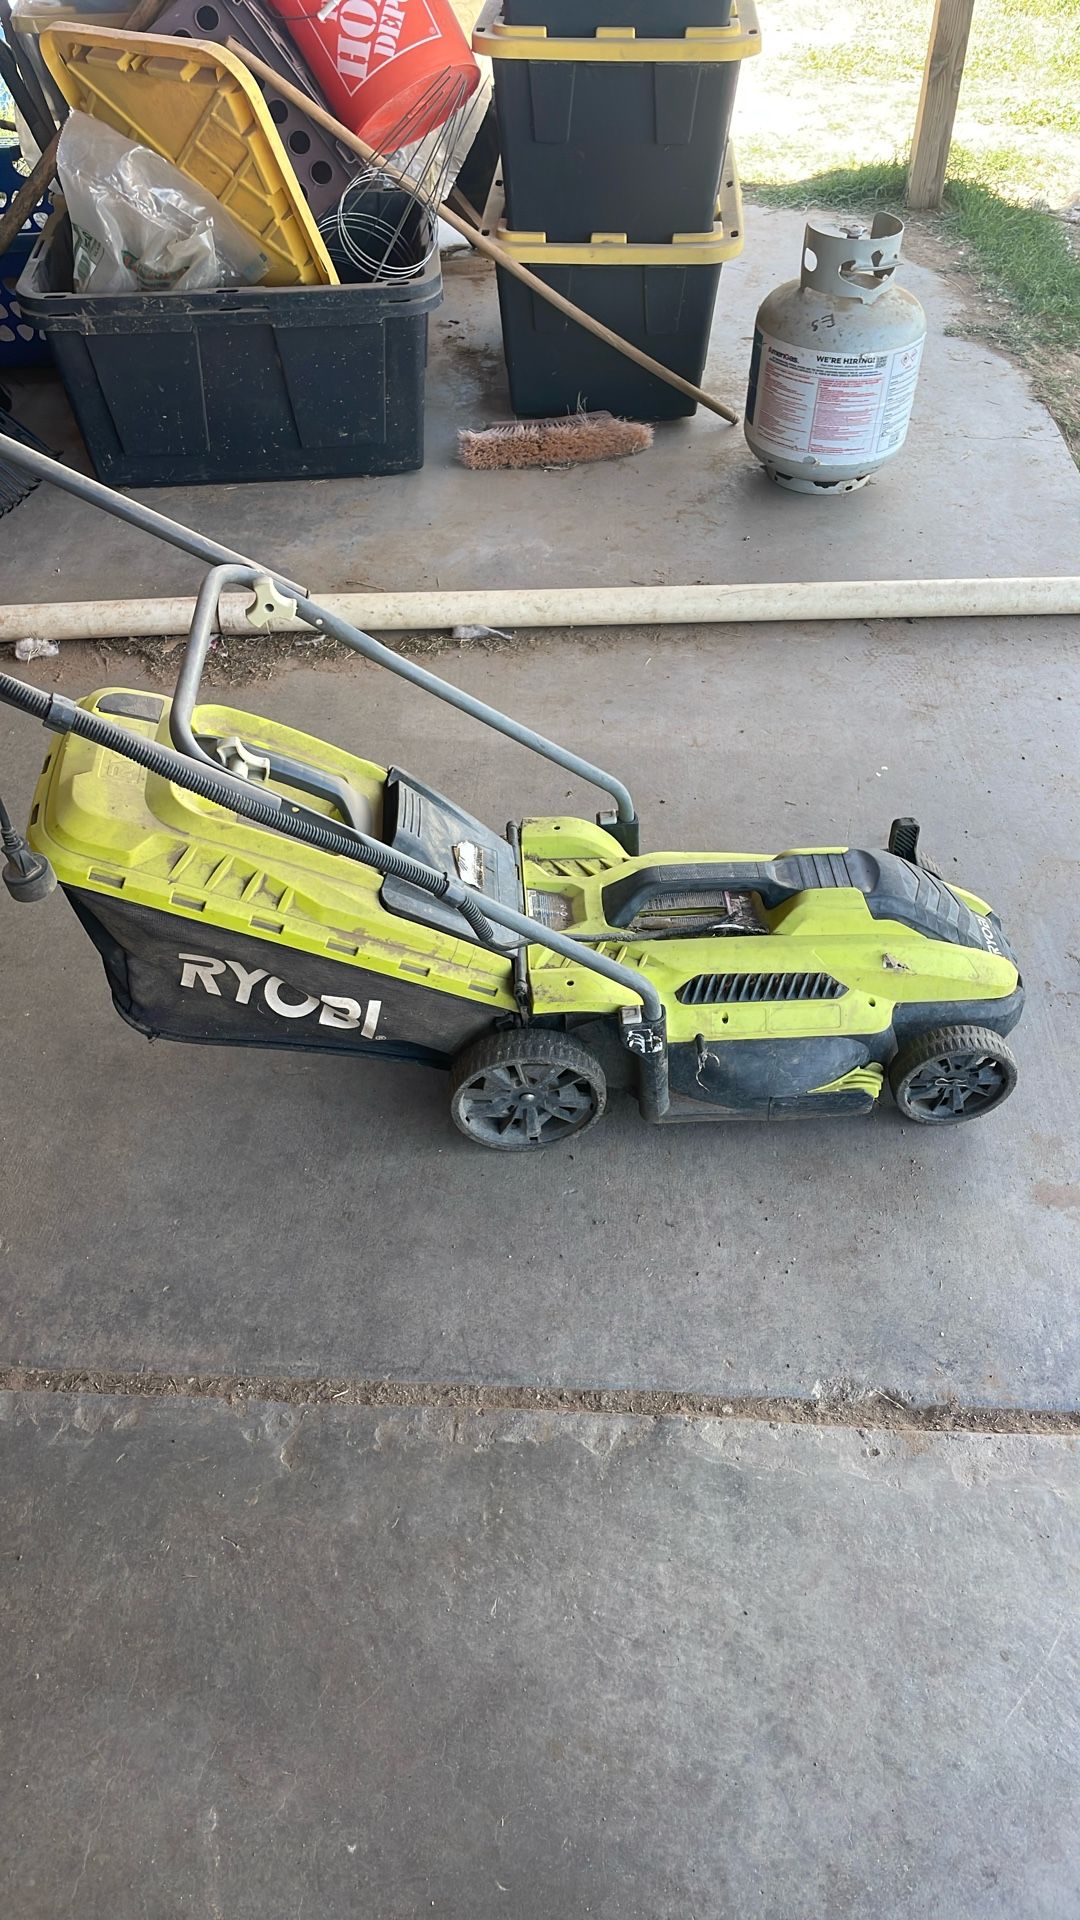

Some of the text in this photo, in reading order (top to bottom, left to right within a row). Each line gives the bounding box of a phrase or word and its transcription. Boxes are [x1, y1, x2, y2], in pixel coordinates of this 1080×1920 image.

[816, 355, 876, 365] WE'RE HIRING!
[975, 913, 1002, 956] RYOBI
[178, 952, 382, 1039] RYOBI
